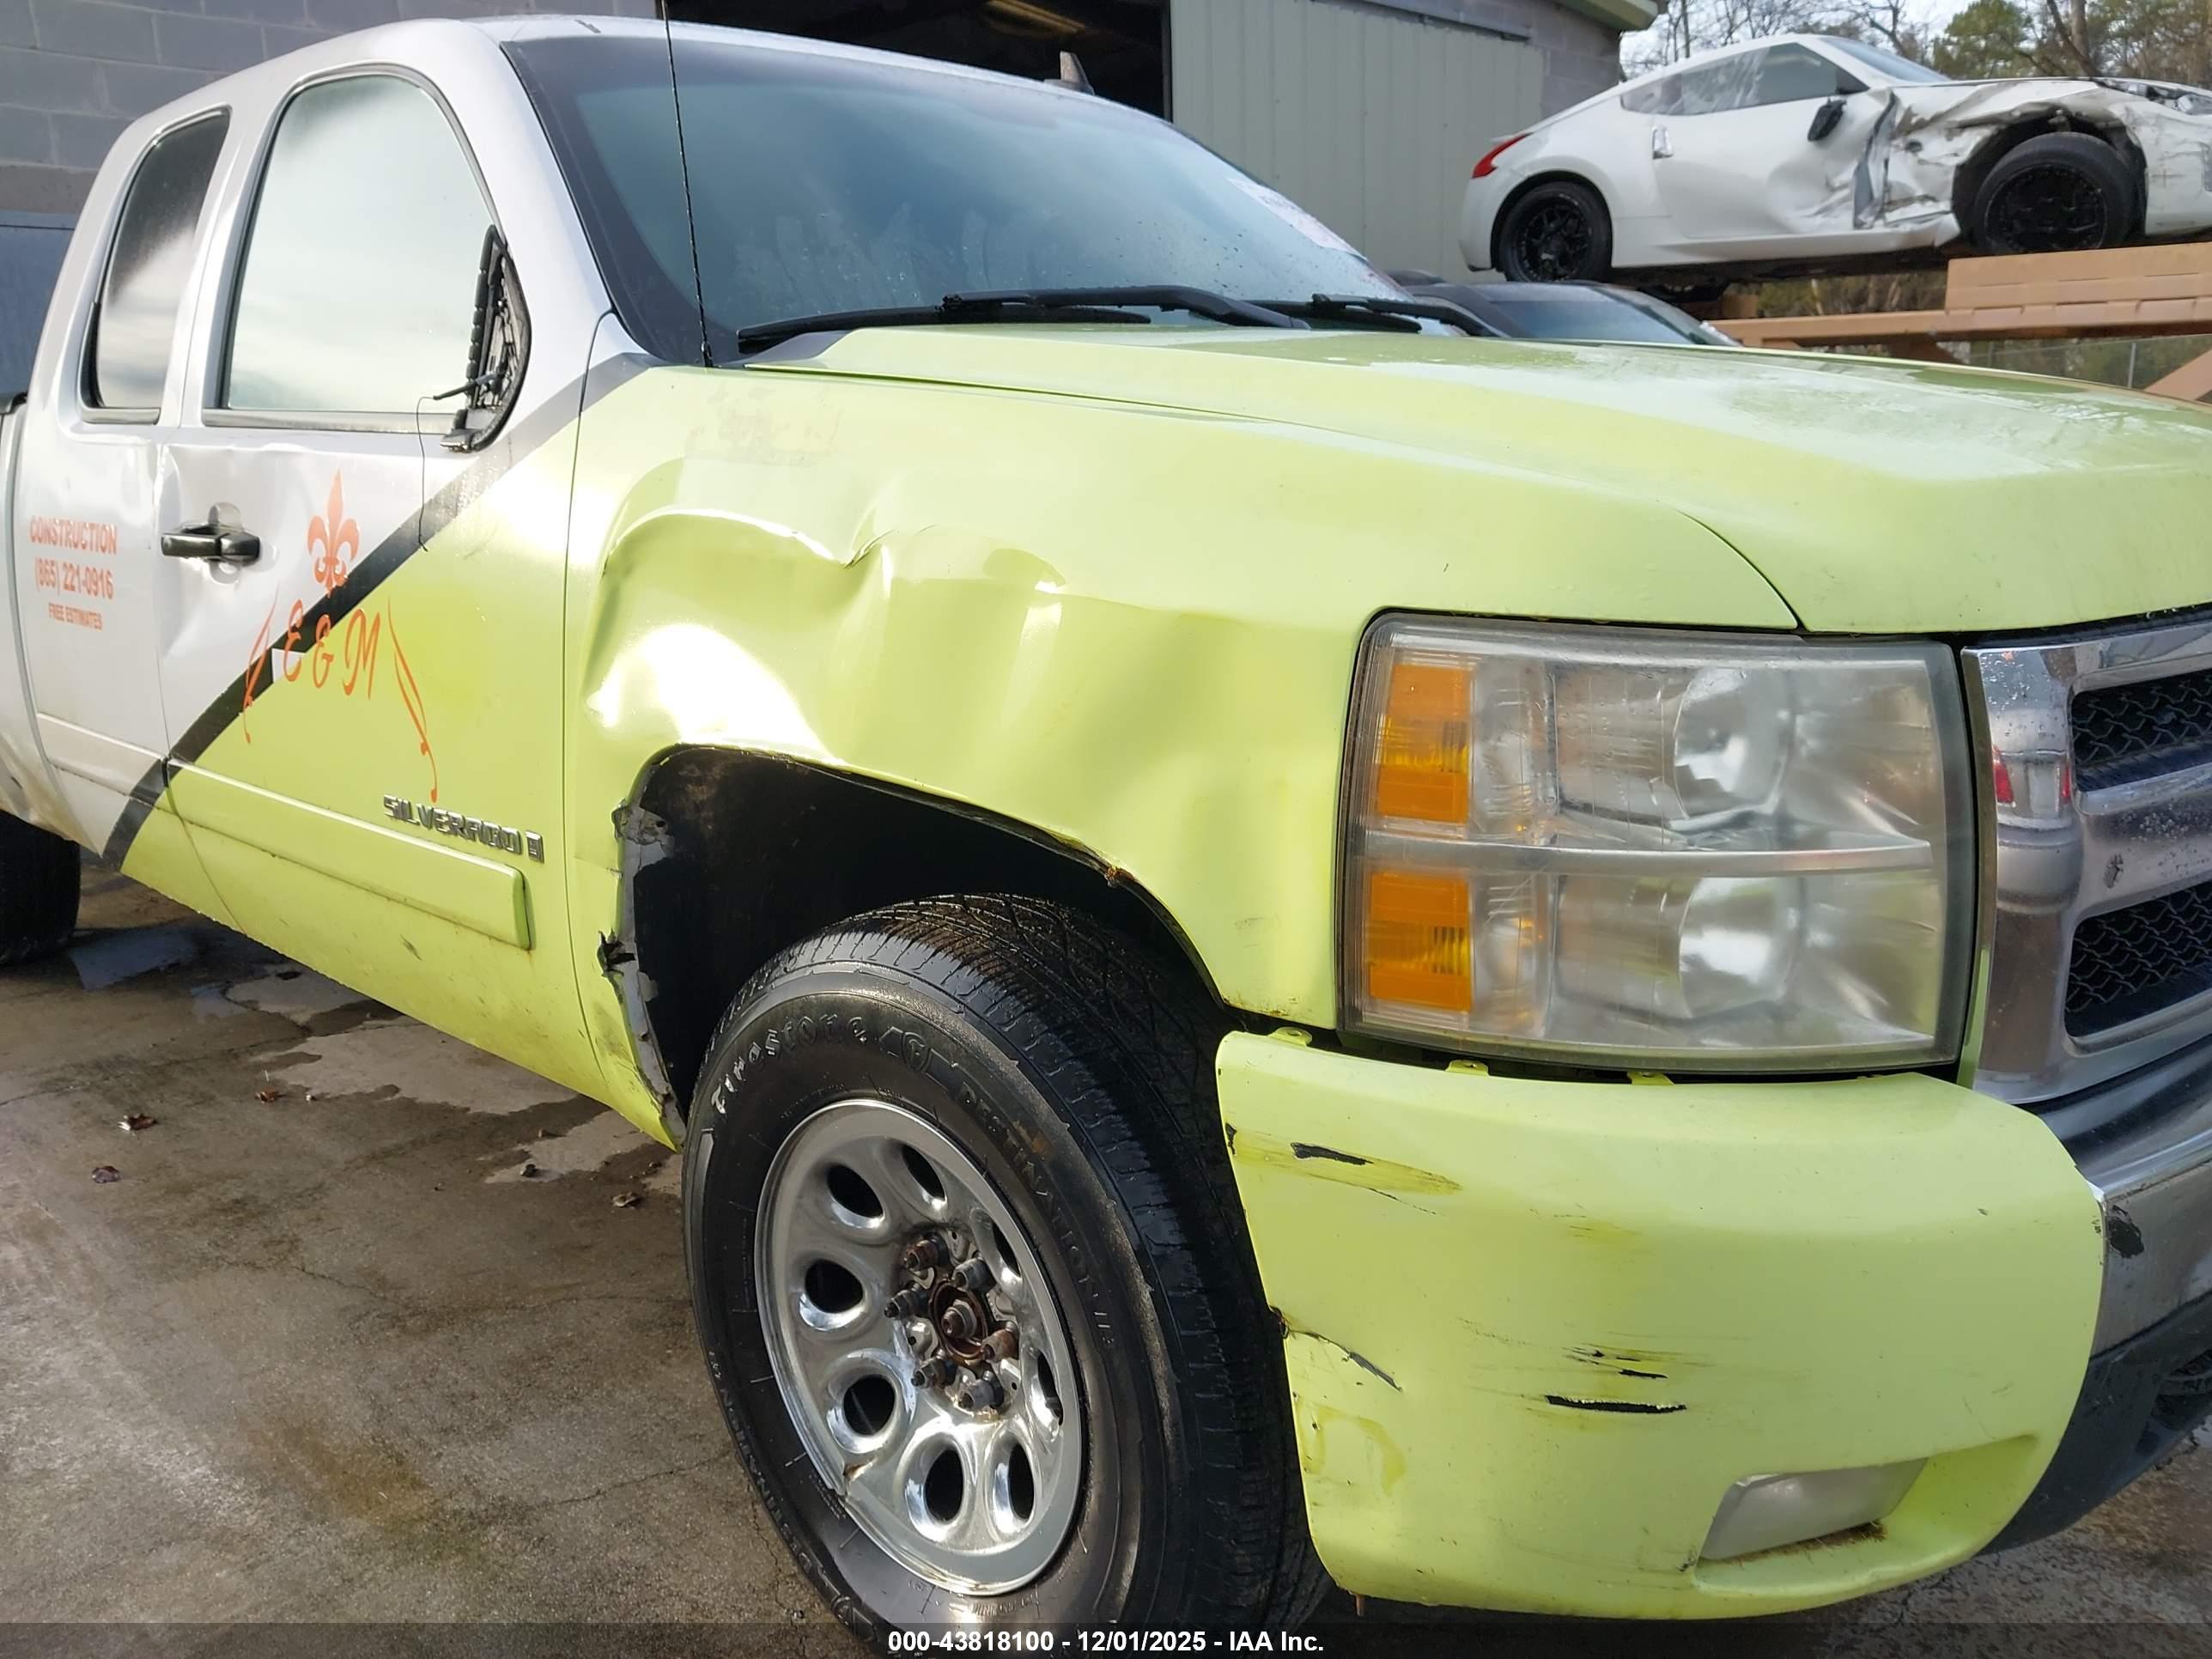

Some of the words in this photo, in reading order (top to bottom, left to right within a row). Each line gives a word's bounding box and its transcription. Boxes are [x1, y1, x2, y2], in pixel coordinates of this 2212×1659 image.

[29, 515, 118, 555] CONSTRUCTION
[63, 562, 114, 599] 221-0916
[48, 602, 64, 622] FREE
[65, 605, 103, 631] ESTIMATES
[383, 793, 523, 855] SILVERADO
